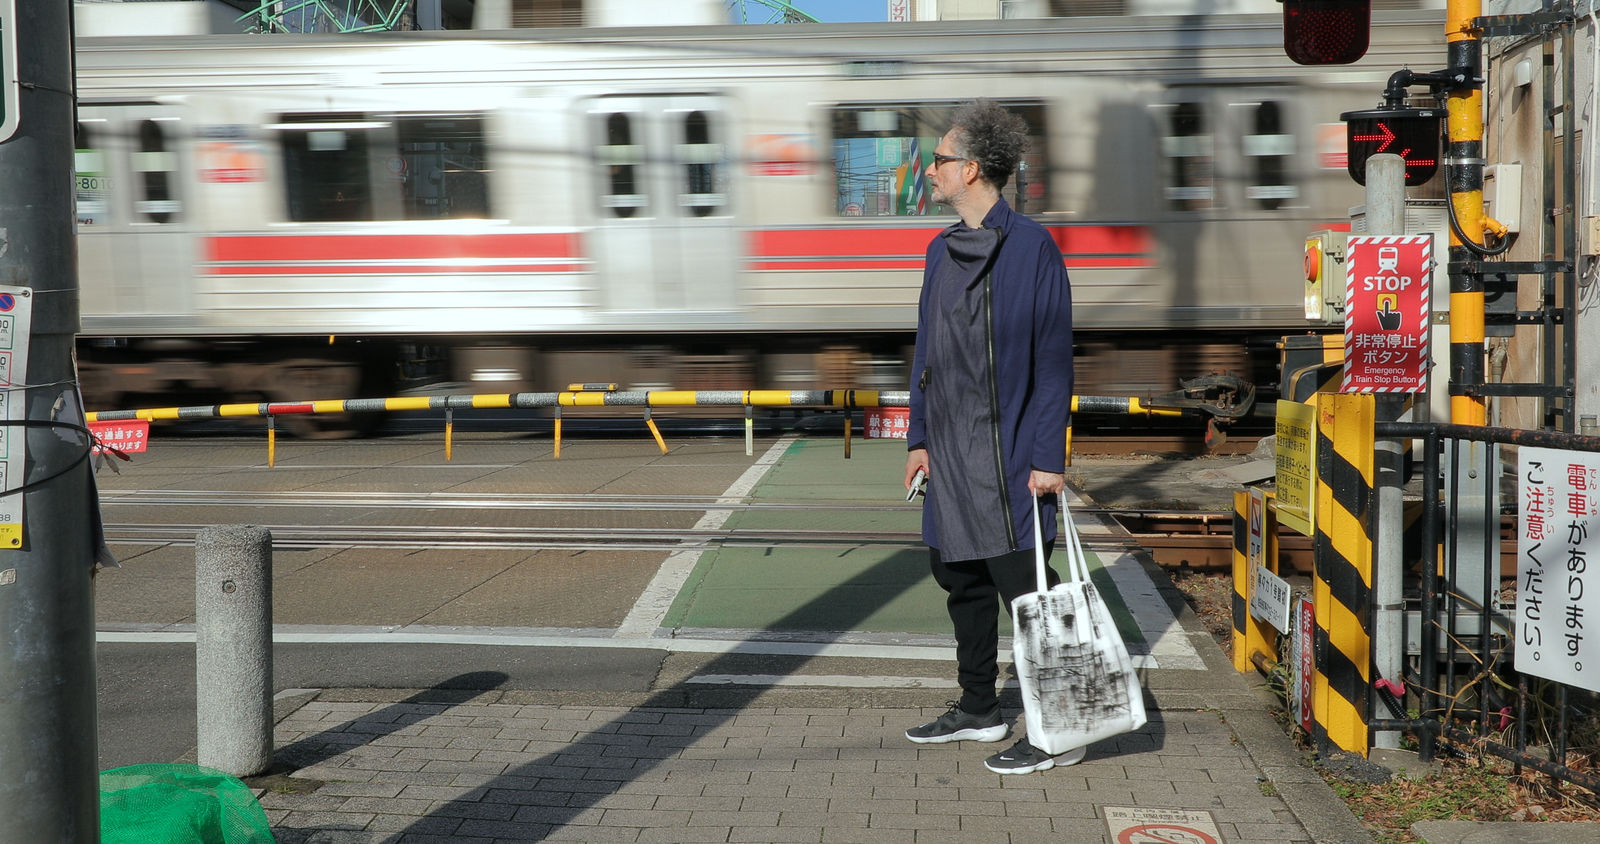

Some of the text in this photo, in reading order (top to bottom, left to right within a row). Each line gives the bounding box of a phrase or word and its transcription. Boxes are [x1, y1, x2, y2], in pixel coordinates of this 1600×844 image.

[1363, 276, 1412, 291] STOP
[1355, 334, 1417, 349] 非常停止
[1363, 351, 1409, 364] ボタン
[1364, 367, 1406, 376] Emergency
[1374, 376, 1392, 384] Stop
[1393, 376, 1417, 384] Button
[1523, 461, 1545, 662] ご注意ください。
[1565, 463, 1588, 672] 電車があります。
